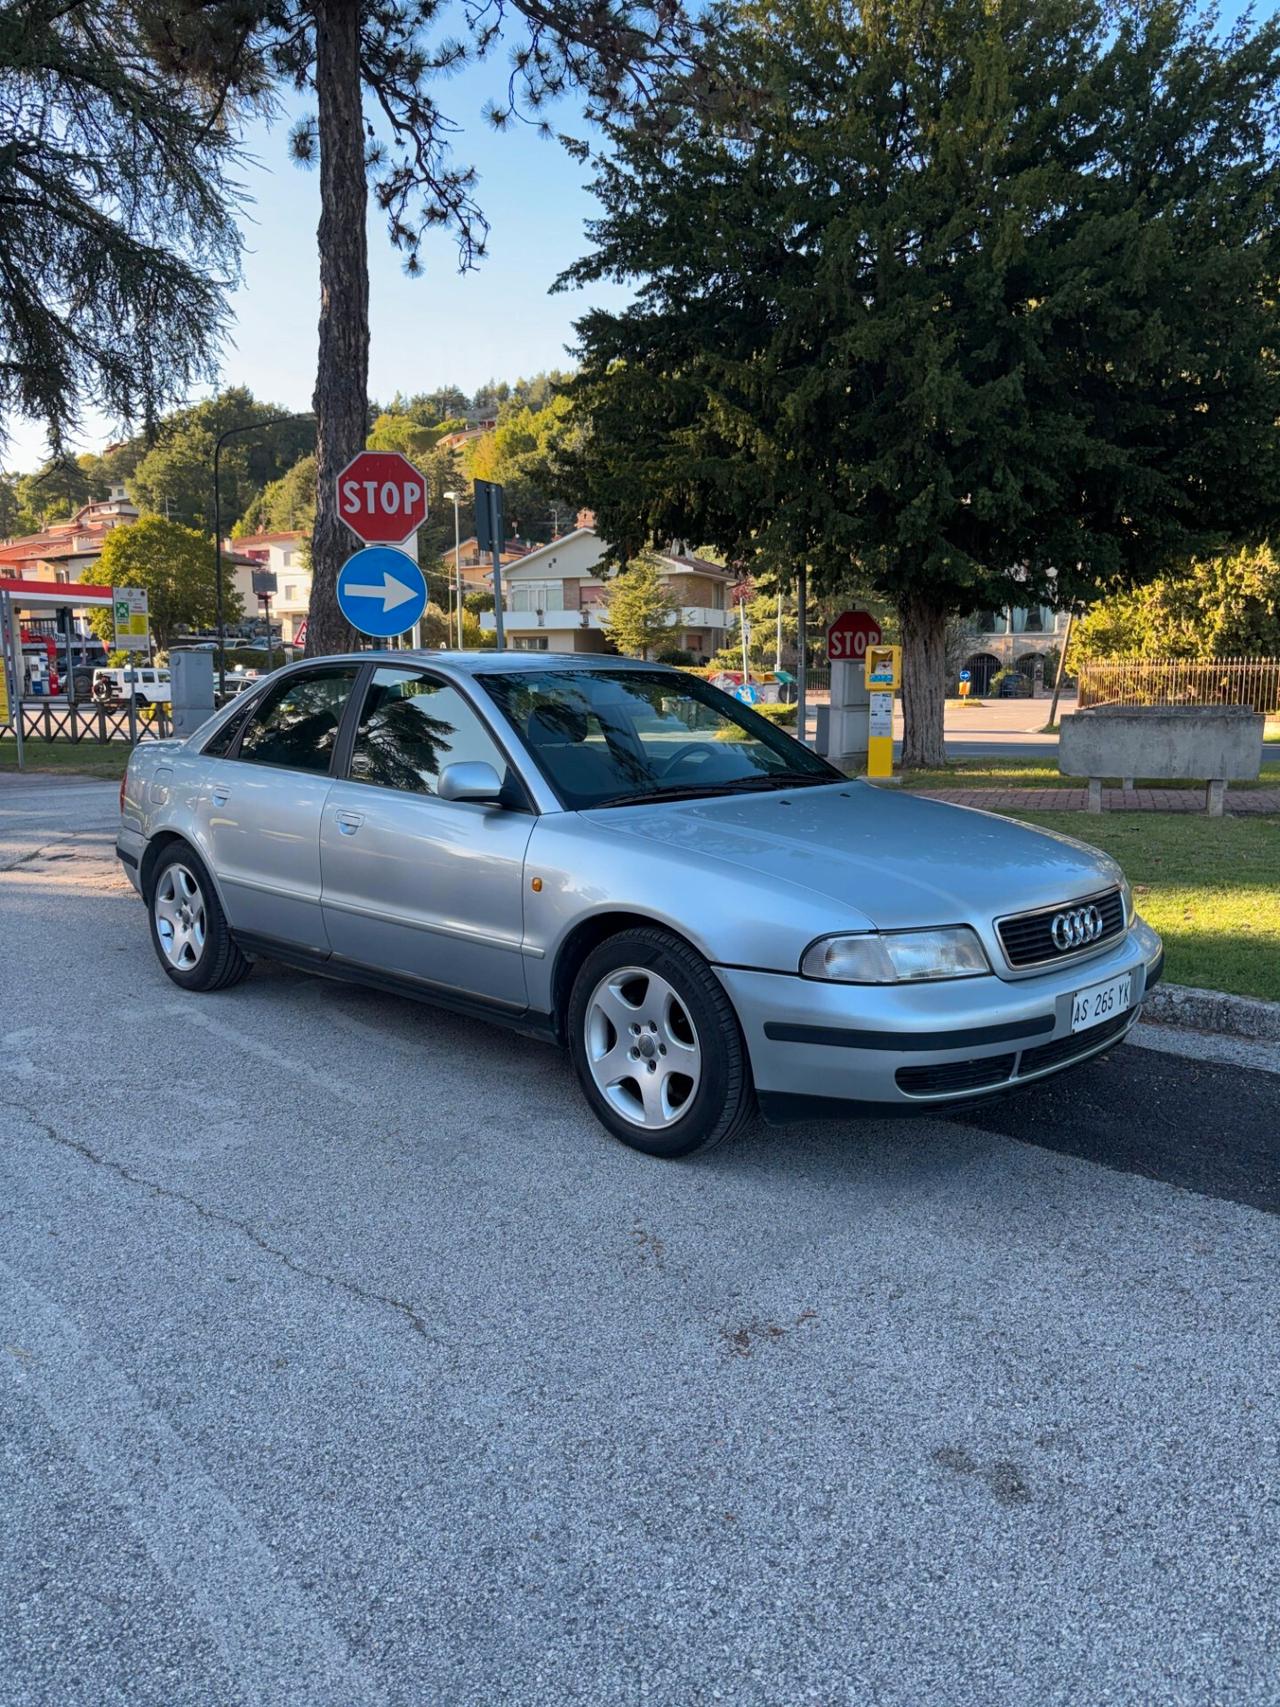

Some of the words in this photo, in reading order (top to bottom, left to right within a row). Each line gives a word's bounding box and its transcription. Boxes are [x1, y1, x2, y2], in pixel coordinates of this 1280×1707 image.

[343, 481, 421, 514] STOP
[1073, 999, 1088, 1024] AS
[1094, 988, 1114, 1016] 265
[1119, 981, 1130, 1005] YK
